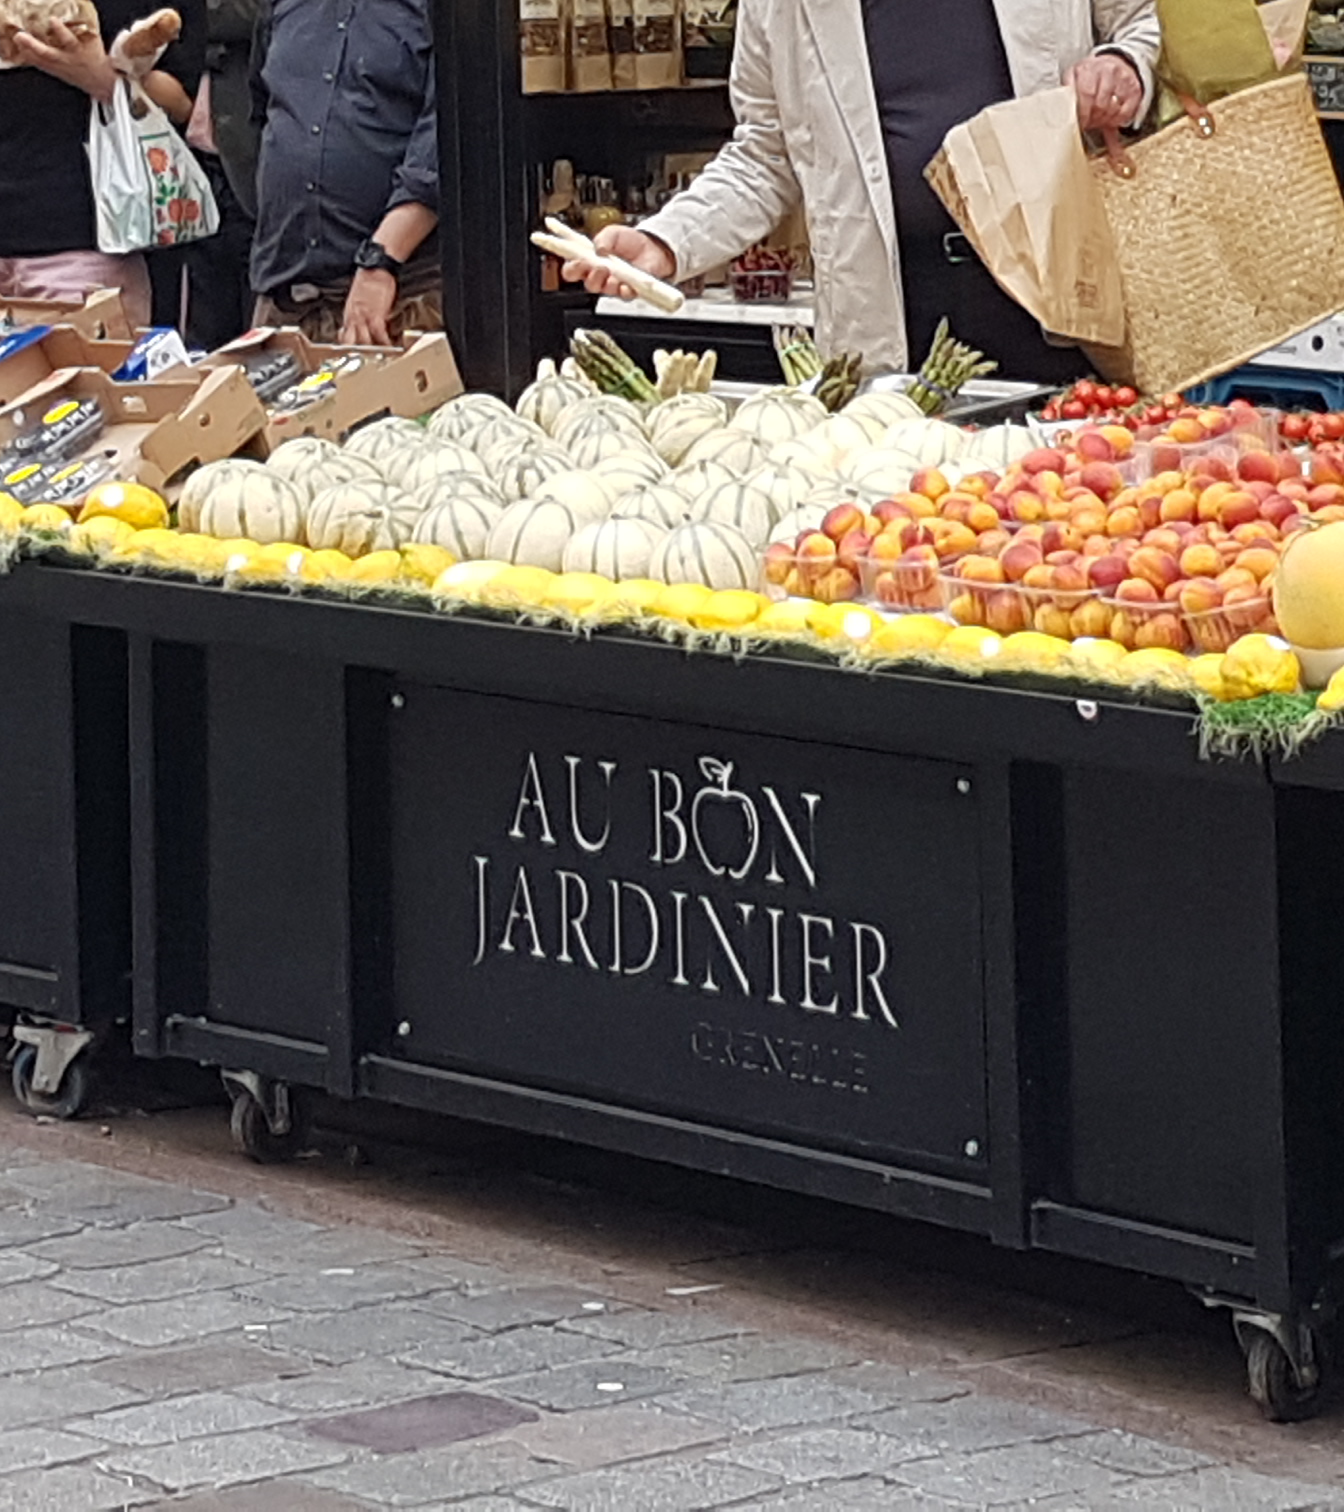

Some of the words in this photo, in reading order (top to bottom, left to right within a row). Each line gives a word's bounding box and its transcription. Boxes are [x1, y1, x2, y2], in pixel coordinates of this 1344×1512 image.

[508, 751, 617, 852] AU
[647, 755, 821, 888] BON
[472, 855, 901, 1030] JARDINIER
